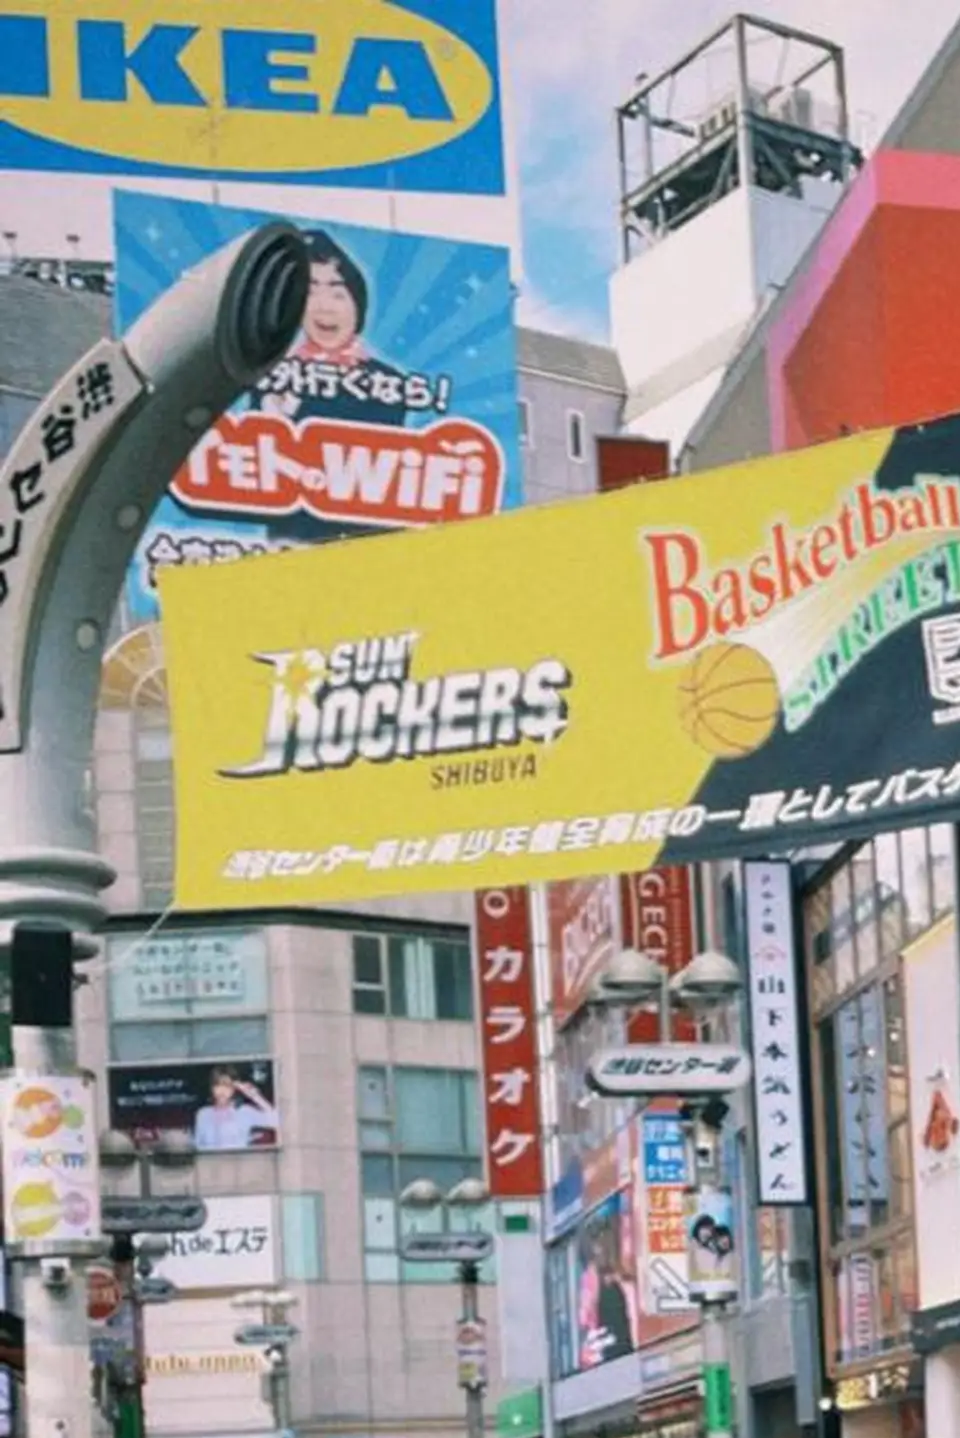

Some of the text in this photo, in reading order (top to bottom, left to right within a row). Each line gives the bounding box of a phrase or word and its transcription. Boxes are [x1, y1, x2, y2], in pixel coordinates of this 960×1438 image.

[0, 14, 456, 122] IKEA
[327, 630, 420, 685] SUN
[216, 650, 572, 778] ROCKERS
[430, 753, 538, 791] SHIBUYA
[483, 945, 534, 1167] カラオケ
